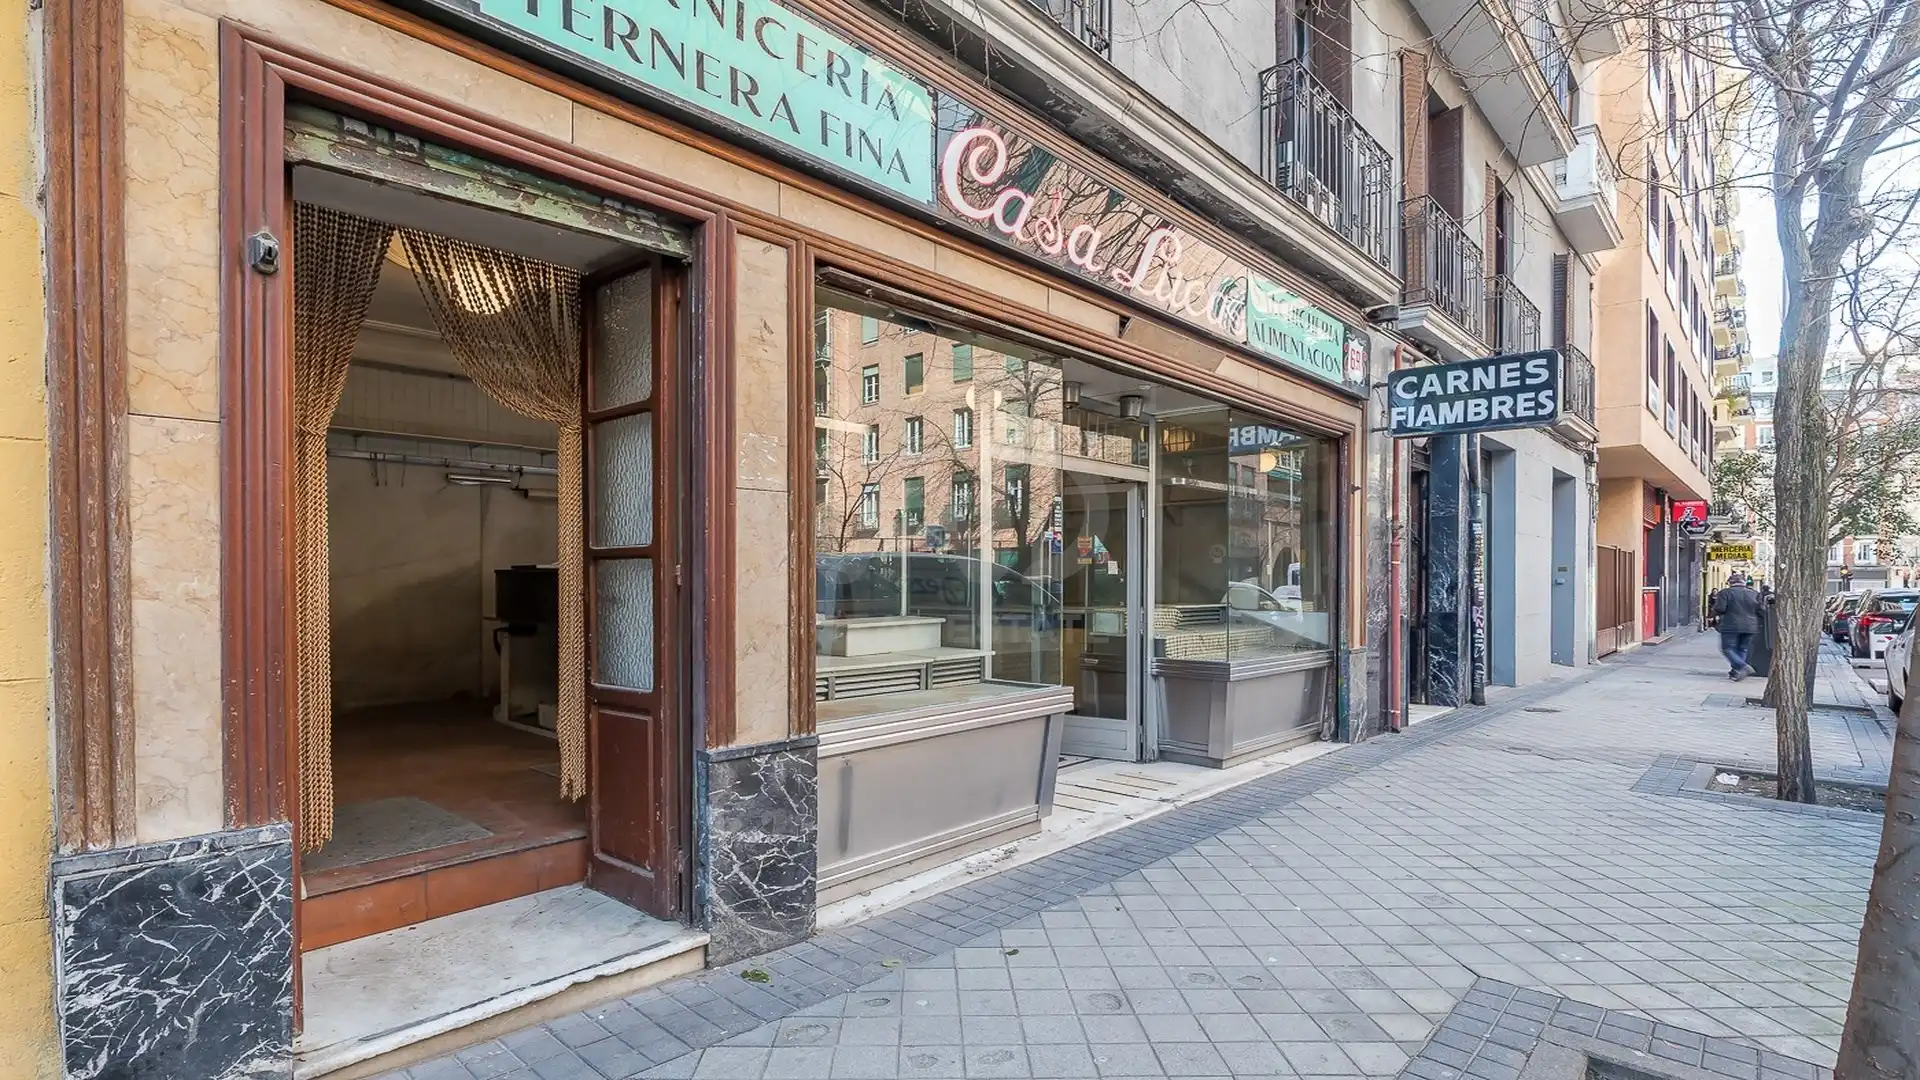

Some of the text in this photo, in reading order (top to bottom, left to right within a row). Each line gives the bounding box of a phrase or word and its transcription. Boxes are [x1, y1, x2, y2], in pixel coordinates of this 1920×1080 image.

[667, 0, 899, 121] NICERIA
[820, 110, 911, 184] FINA
[941, 125, 1103, 272] Casa
[1252, 321, 1341, 375] ALIMENTACION
[1395, 358, 1549, 399] CARNES
[1390, 389, 1553, 430] FIAMBRES
